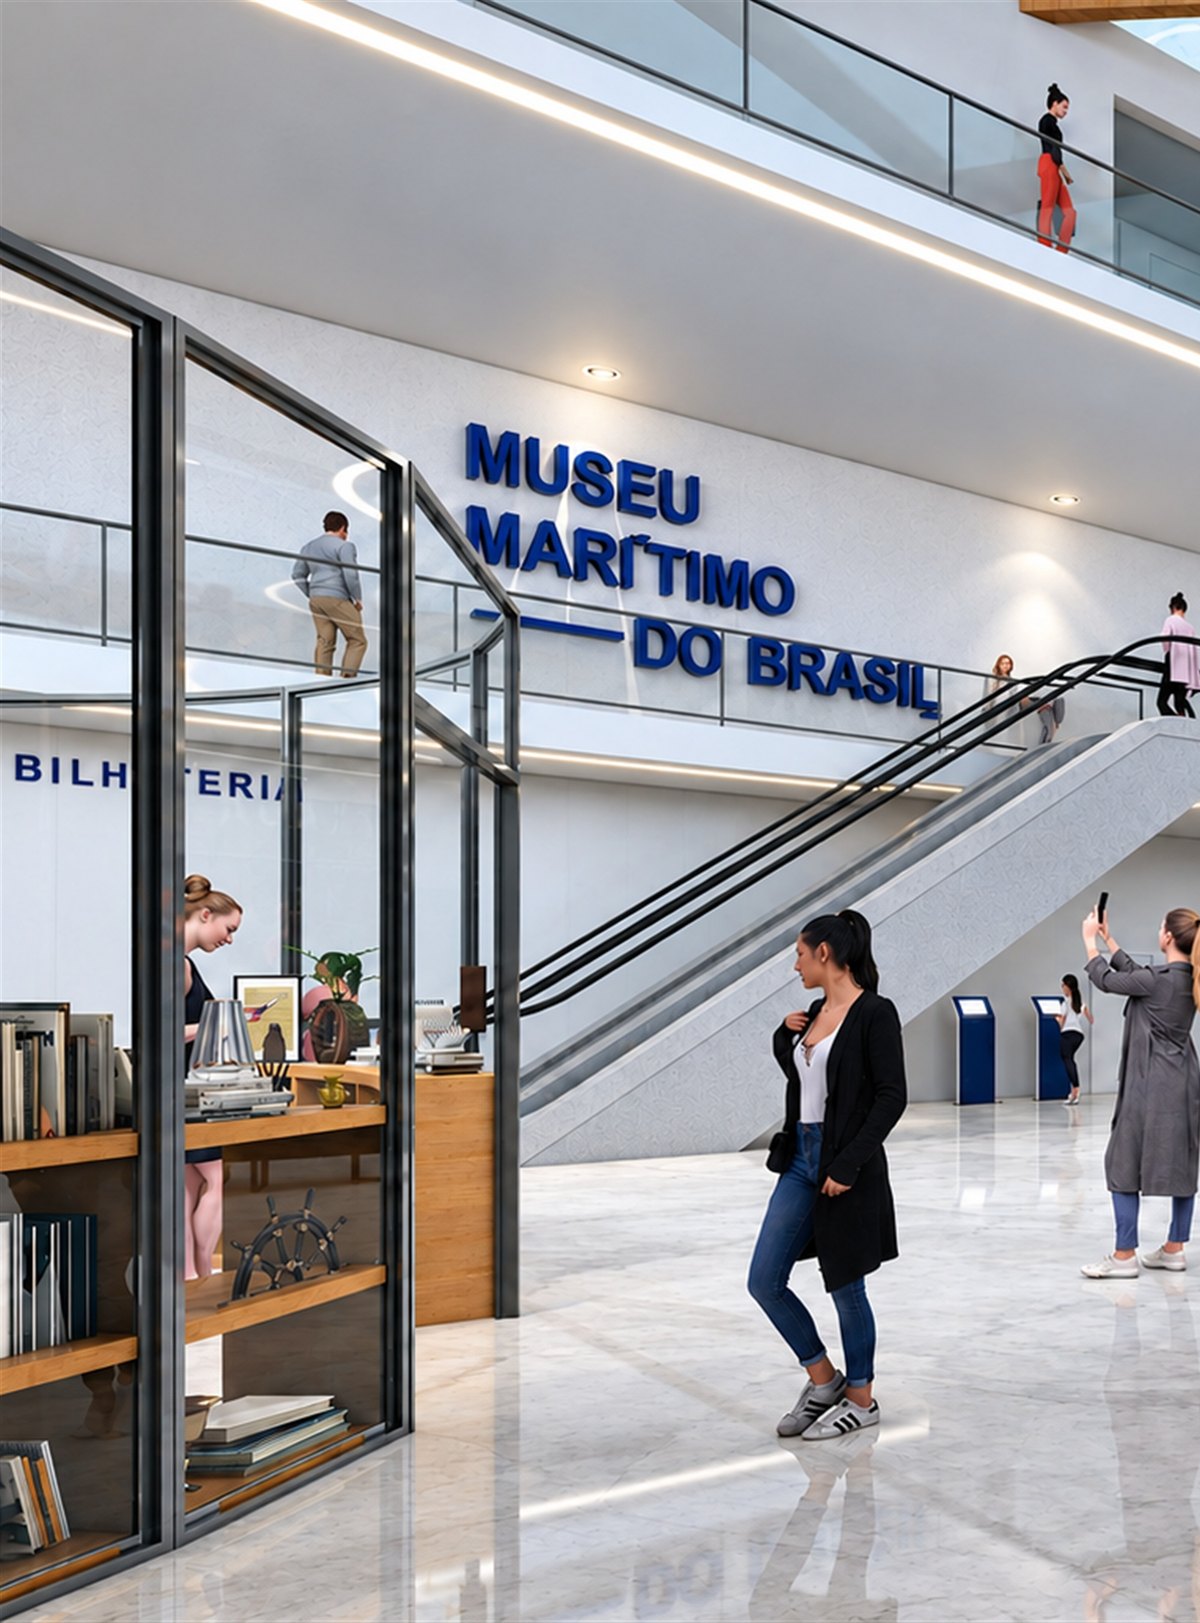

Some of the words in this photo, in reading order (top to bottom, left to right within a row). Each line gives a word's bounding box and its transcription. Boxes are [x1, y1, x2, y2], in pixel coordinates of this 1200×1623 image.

[465, 422, 701, 526] MUSEU
[465, 505, 796, 617] MARÍTIMO
[633, 617, 723, 677] DO
[747, 635, 941, 718] BRASIL
[14, 753, 303, 804] BILHERIA
